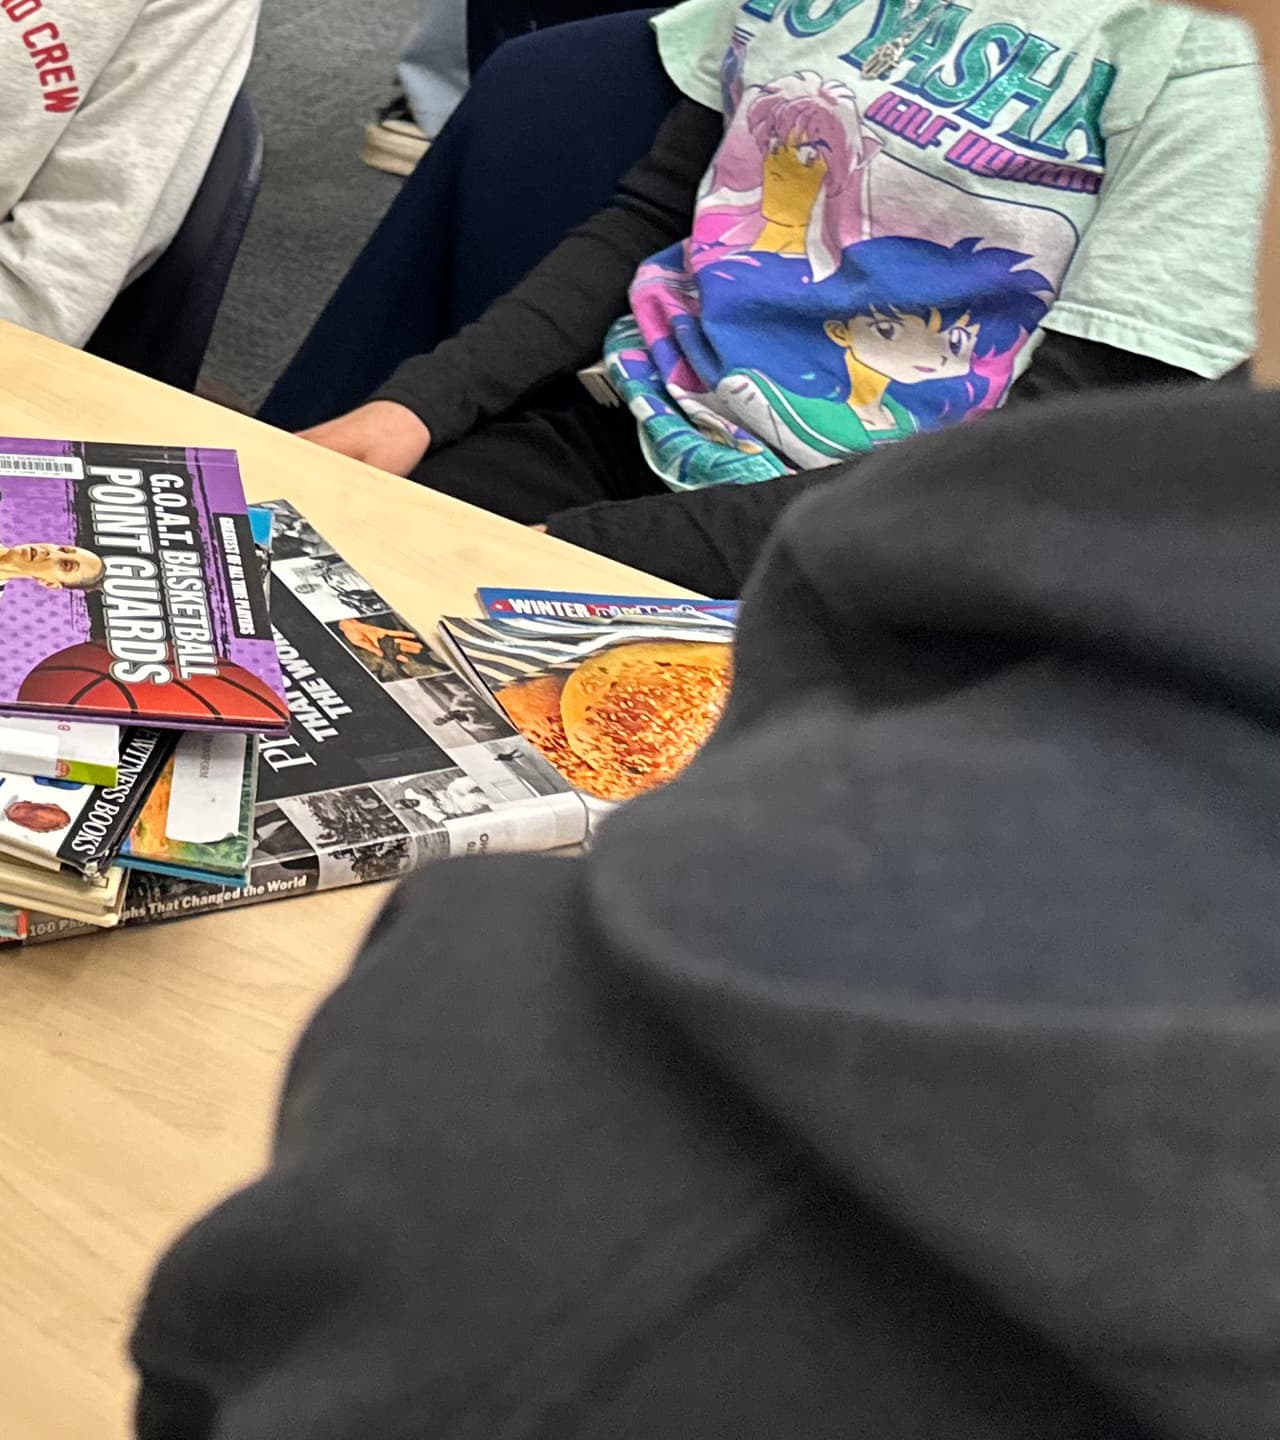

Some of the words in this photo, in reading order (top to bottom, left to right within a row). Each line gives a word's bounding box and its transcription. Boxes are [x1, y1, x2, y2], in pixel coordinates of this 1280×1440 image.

[22, 22, 81, 114] CREW
[88, 465, 153, 554] POINT
[102, 555, 173, 684] GUARDS
[158, 549, 219, 680] BASKETBALL
[507, 597, 591, 619] WINTER
[298, 676, 353, 721] THE
[100, 728, 161, 804] EWITNESS
[71, 799, 121, 856] BOOKS
[148, 896, 180, 916] That
[182, 886, 241, 911] Changed
[242, 882, 265, 898] the
[266, 874, 308, 893] World
